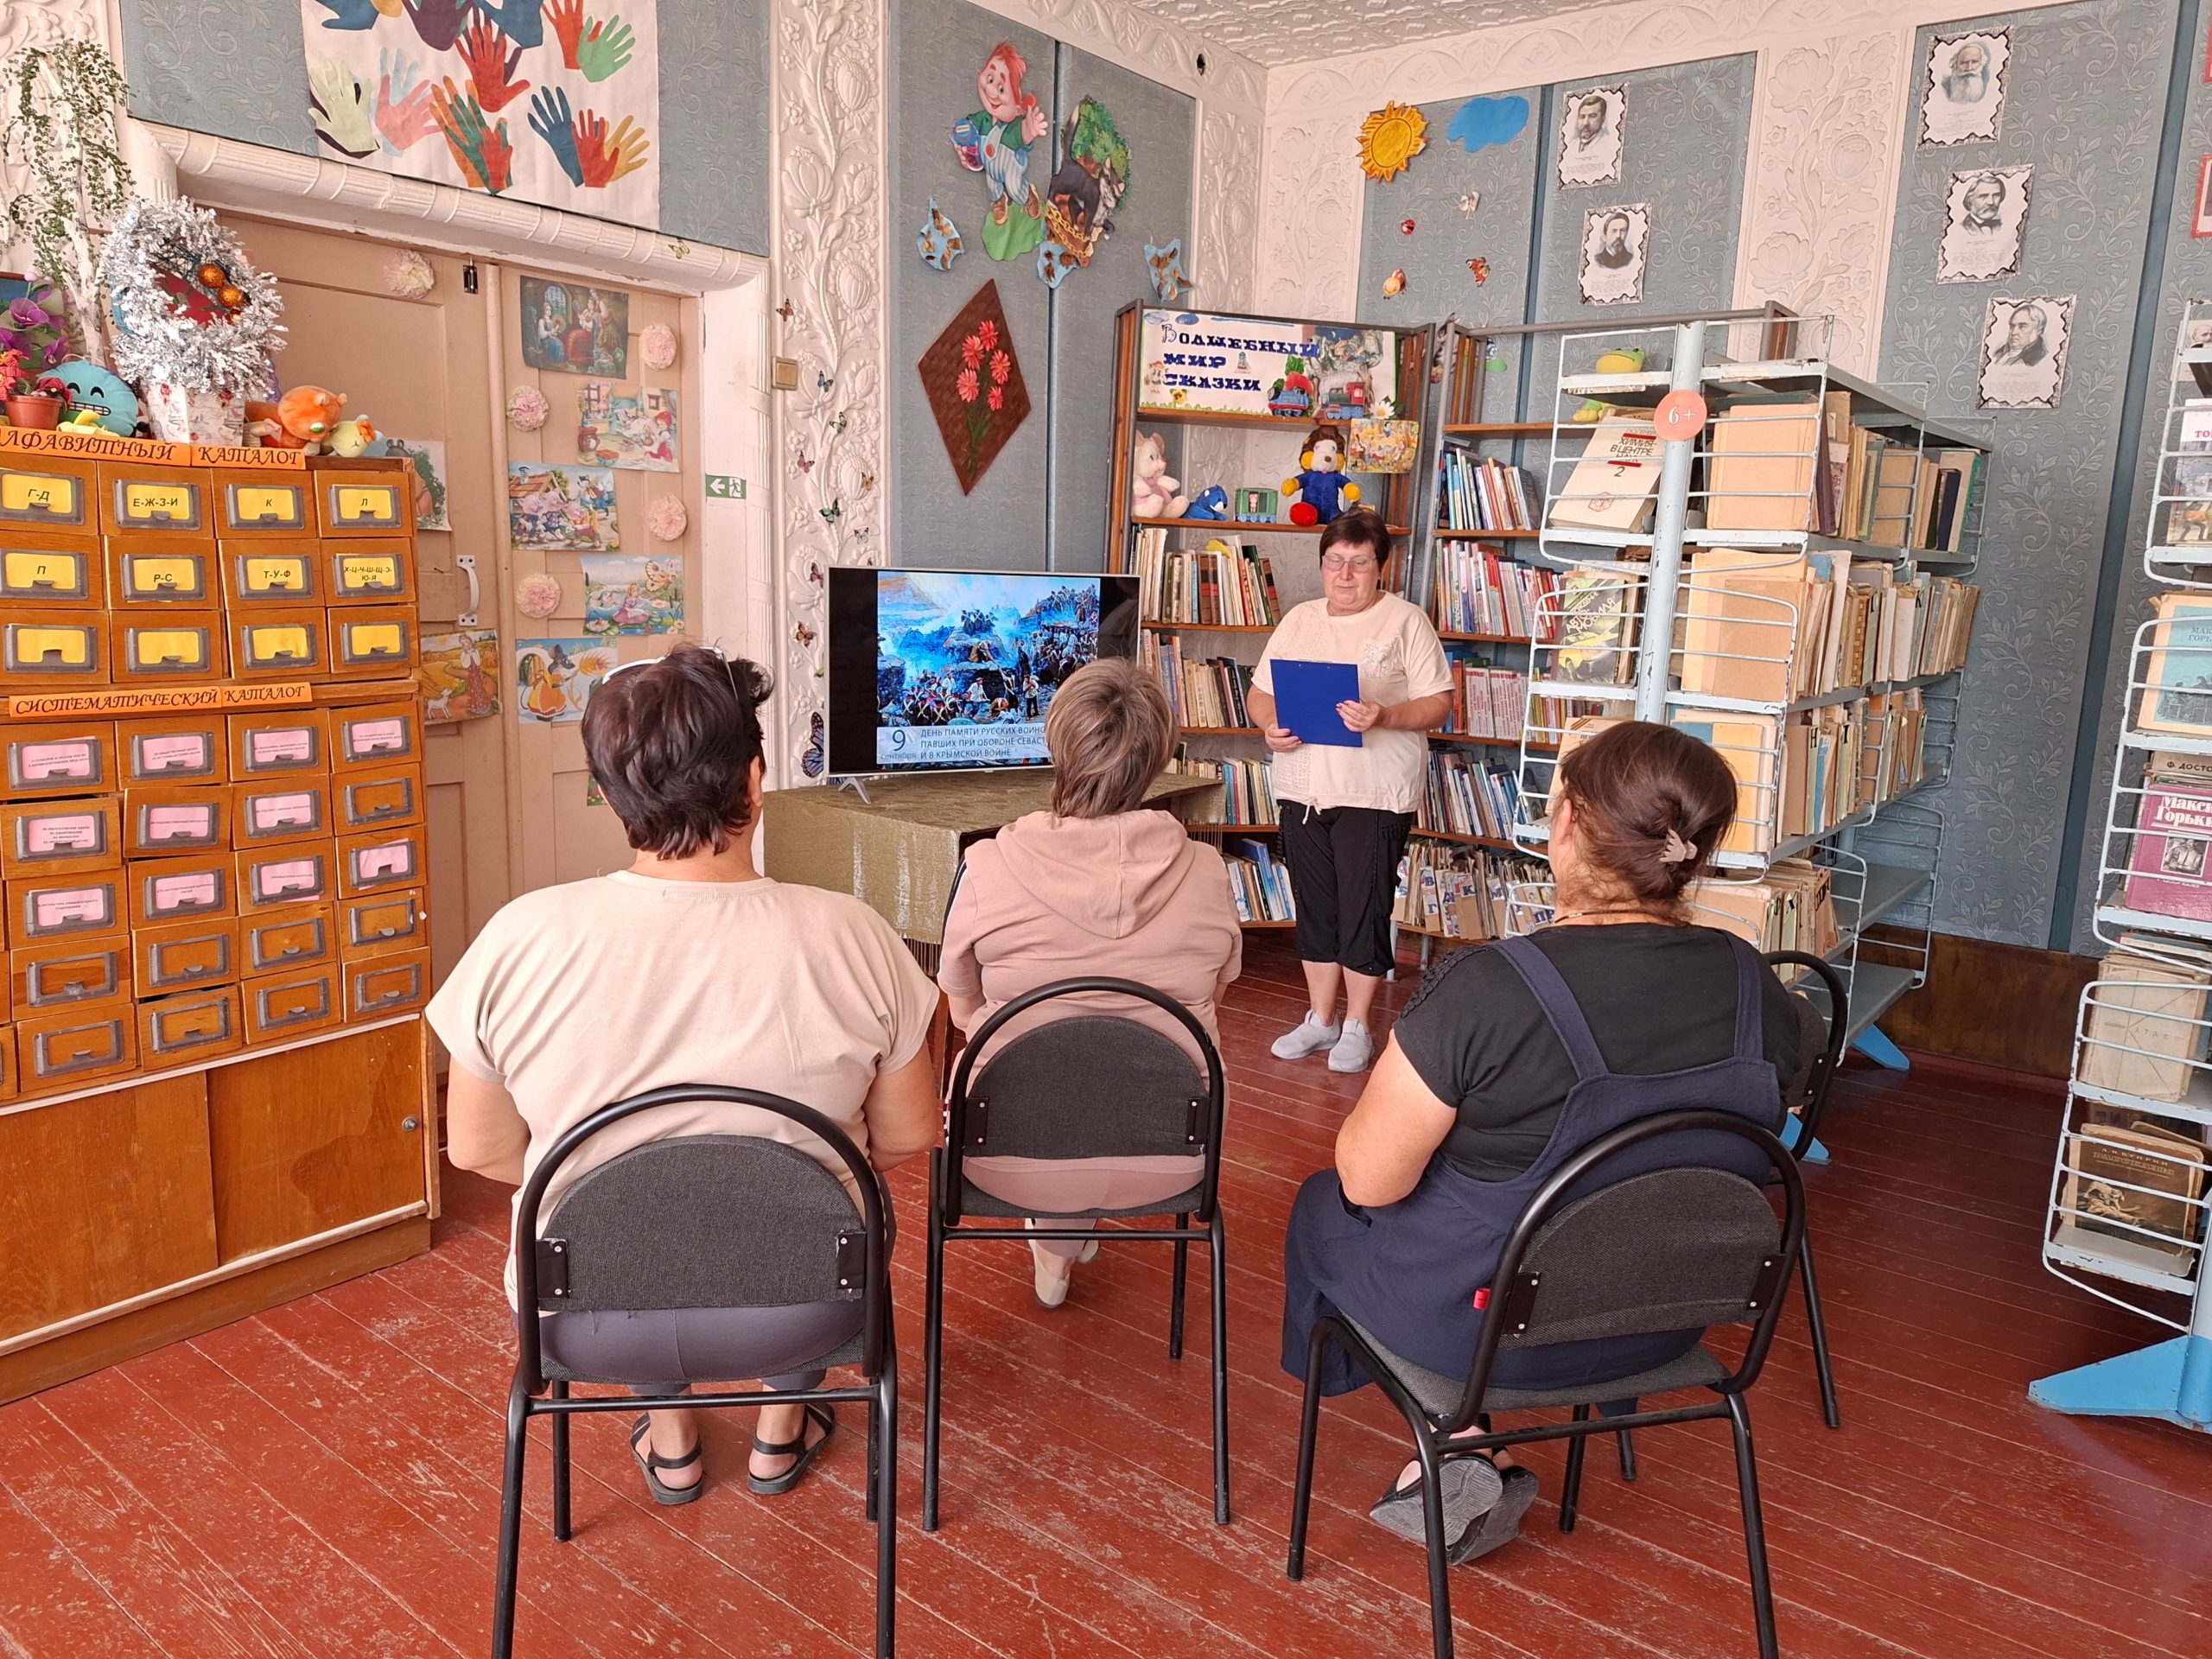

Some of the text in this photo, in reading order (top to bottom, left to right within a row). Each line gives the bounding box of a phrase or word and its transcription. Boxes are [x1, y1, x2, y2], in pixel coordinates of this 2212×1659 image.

[1161, 324, 1320, 359] ВОЛШЕБНЫЙ
[1163, 353, 1227, 369] МИР
[1163, 373, 1262, 391] СКАЗКИ
[1668, 404, 1696, 425] 6+
[199, 446, 301, 465] КАТАЛОГ
[1614, 466, 1625, 477] 2
[28, 488, 50, 502] Г-Д
[133, 498, 178, 507] Е-Ж-З-И
[265, 499, 272, 507] К
[360, 498, 368, 506] Л
[36, 565, 46, 575] П
[263, 570, 291, 579] Т-У-Ф
[153, 574, 173, 582] Р-С
[16, 685, 305, 715] СИСТЕМАТИЧЕСКИЙ КАТАЛОГ
[920, 726, 1045, 738] ДЕНЬ ПАМЯТИ РУССКИХ ВОИНО
[892, 729, 906, 752] 9
[920, 736, 1046, 748] ПАВШИХ ПРИ ОБОРОНЕ СЕВАСТ
[920, 751, 927, 760] И
[929, 751, 934, 760] В
[936, 748, 982, 760] КРЫМСКОЙ
[2166, 760, 2177, 769] Ф.
